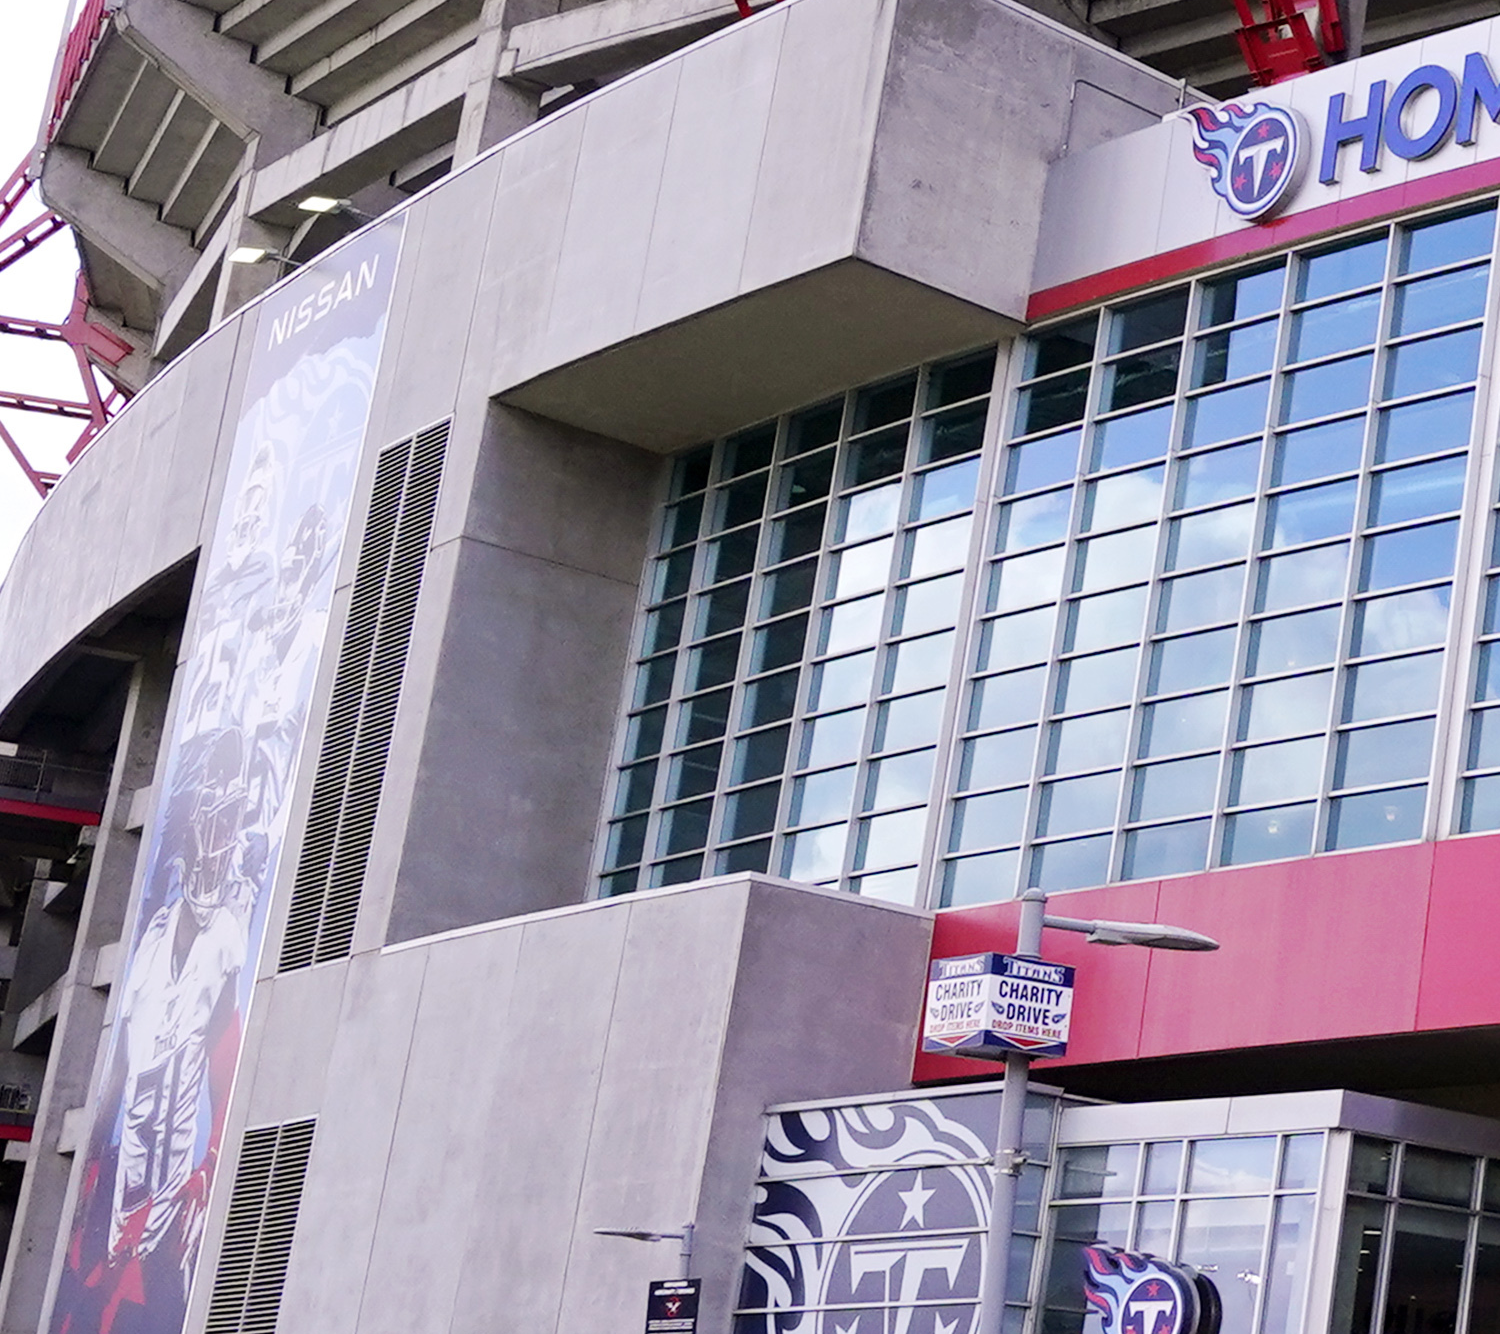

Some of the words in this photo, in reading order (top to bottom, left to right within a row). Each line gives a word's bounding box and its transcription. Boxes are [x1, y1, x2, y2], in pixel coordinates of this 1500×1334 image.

[267, 253, 379, 352] NISSAN
[938, 955, 985, 978] TITANS
[1003, 957, 1065, 984] TITANS
[936, 980, 983, 1001] CHARITY
[999, 980, 1063, 1006] CHARITY
[940, 1002, 973, 1022] DRIVE
[1006, 1003, 1050, 1026] DRIVE
[930, 1024, 945, 1032] DROP
[966, 1019, 980, 1028] HERE
[992, 1019, 1013, 1030] DROP
[1015, 1024, 1039, 1036] ITEMS
[1041, 1028, 1062, 1039] HERE
